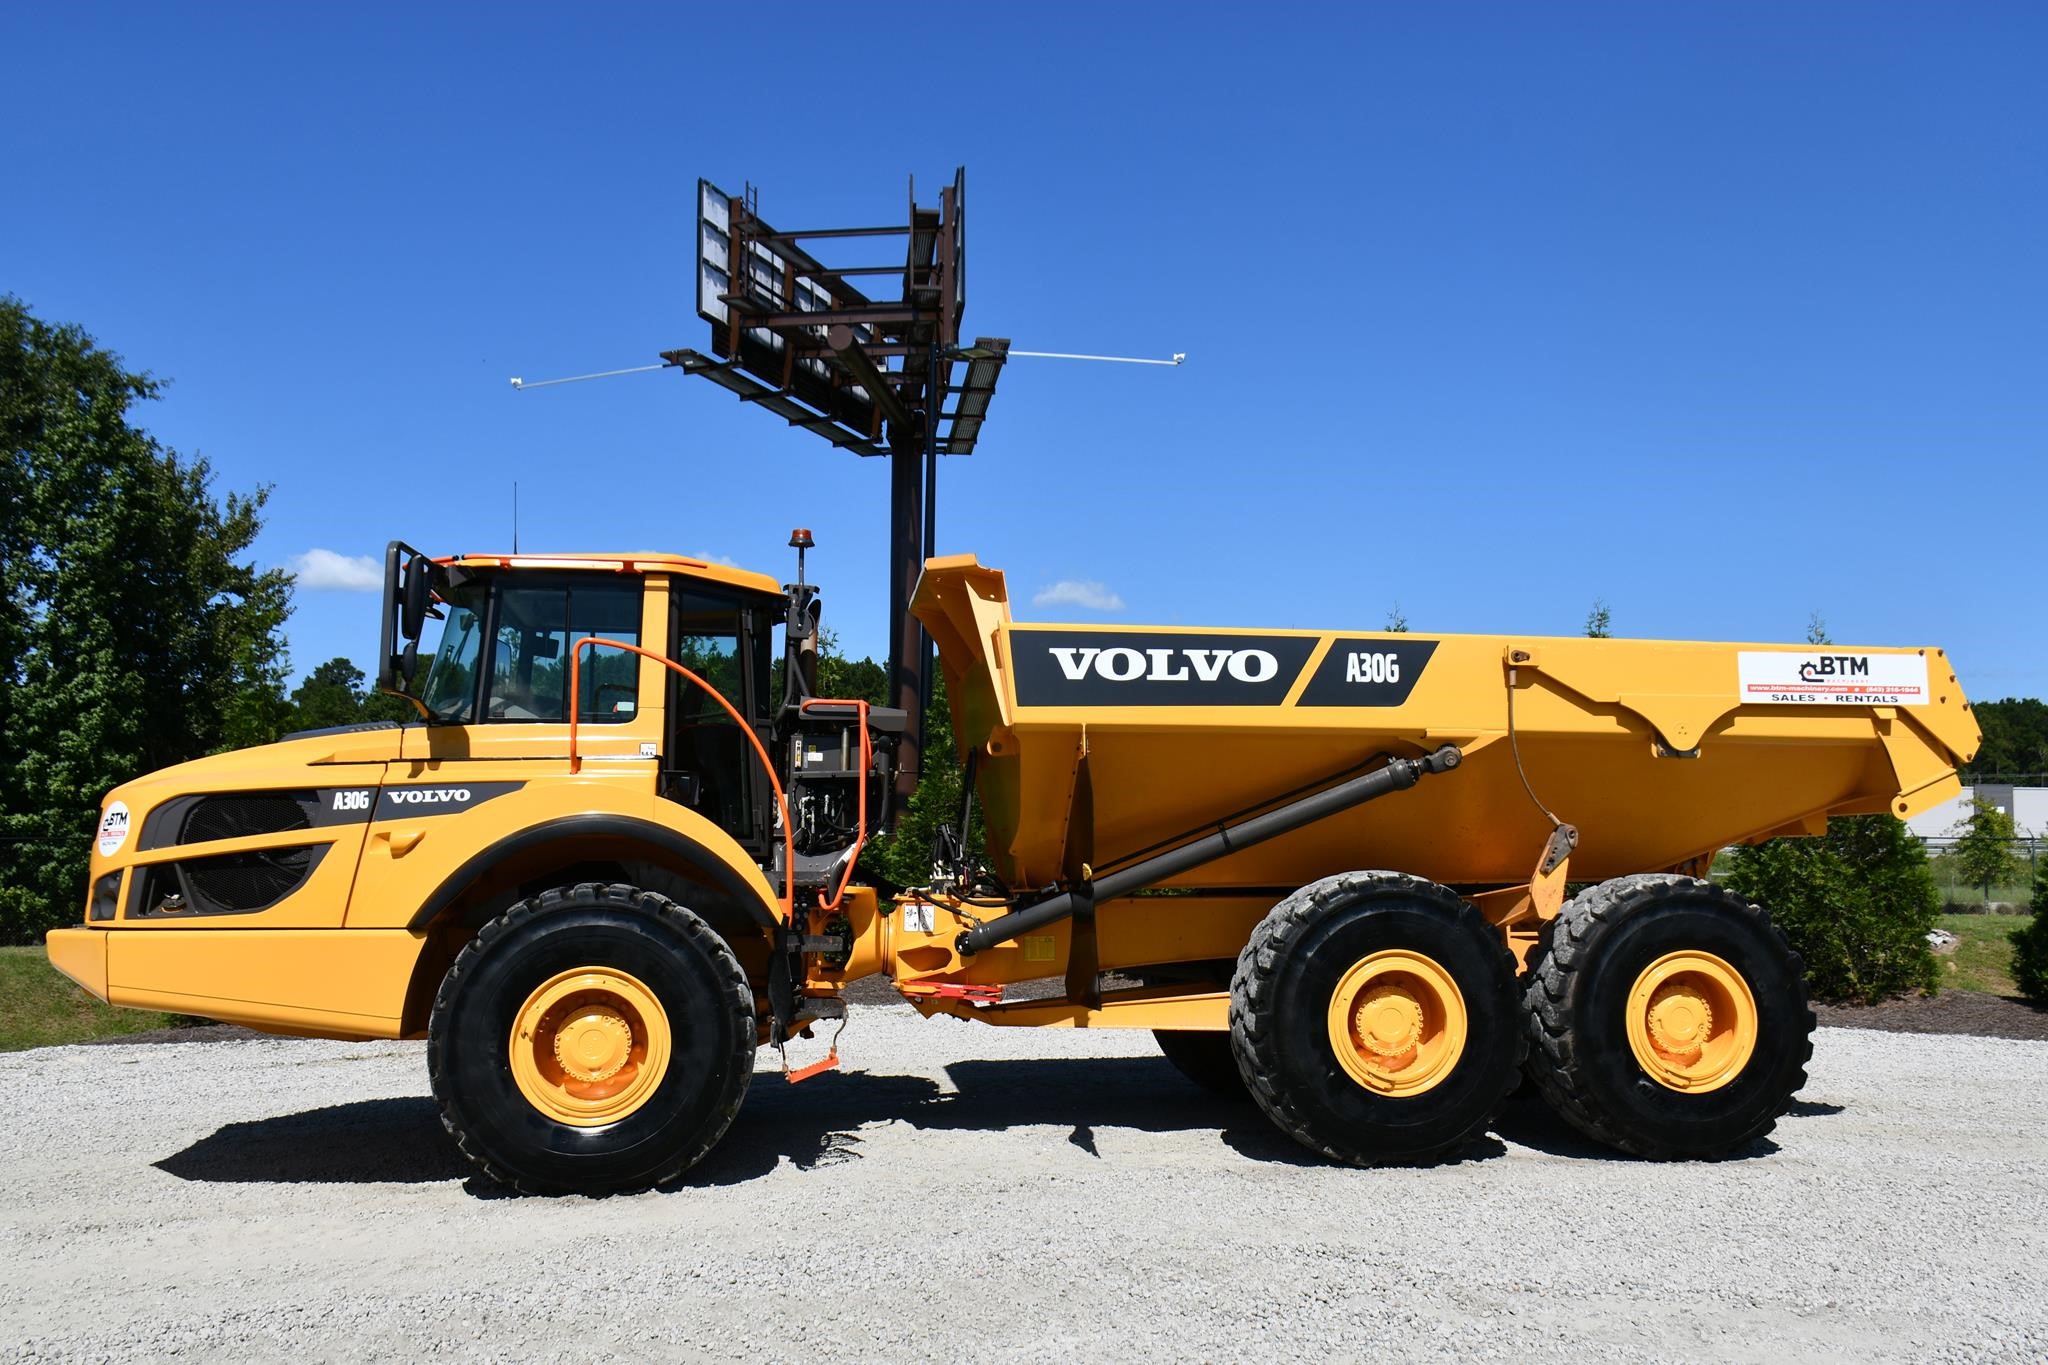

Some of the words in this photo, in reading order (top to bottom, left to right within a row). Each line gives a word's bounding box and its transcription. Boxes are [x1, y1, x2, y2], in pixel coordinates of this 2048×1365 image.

[1048, 647, 1279, 683] VOLVO
[1346, 652, 1400, 684] A30G
[1820, 656, 1869, 675] BTM
[1771, 694, 1816, 702] SALES
[1835, 695, 1899, 703] RENTALS
[332, 791, 370, 810] A30G
[387, 789, 471, 804] VOLVO
[110, 811, 128, 826] BTM
